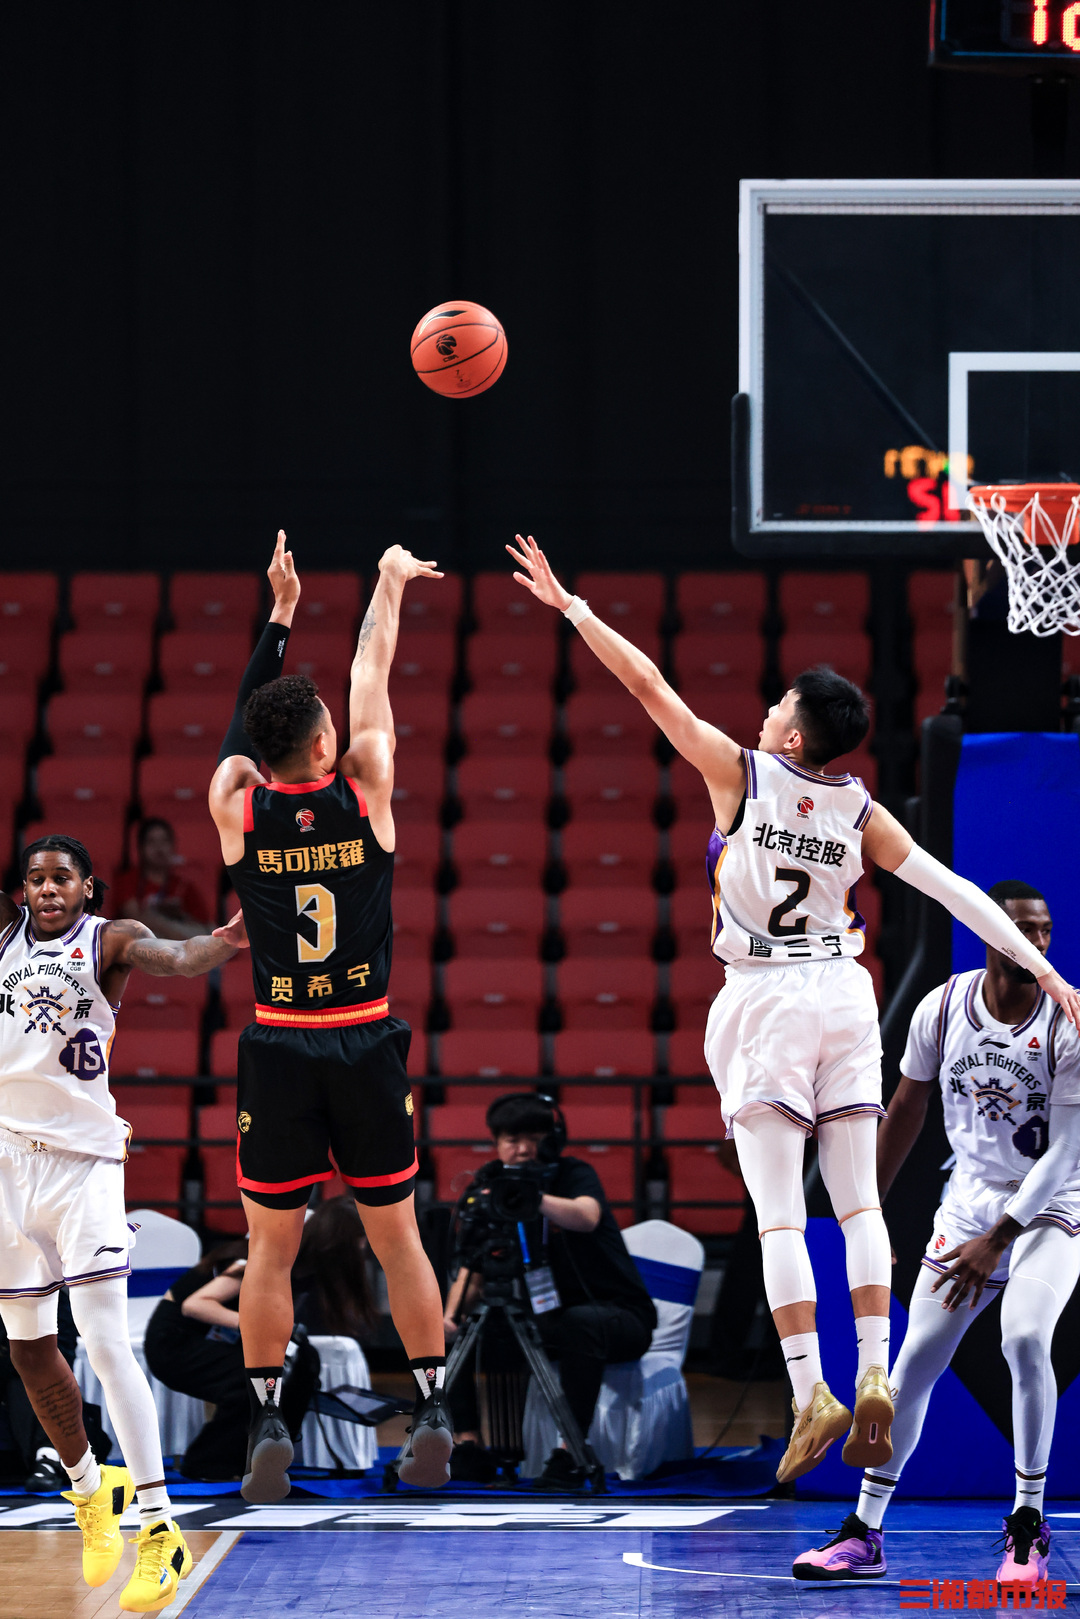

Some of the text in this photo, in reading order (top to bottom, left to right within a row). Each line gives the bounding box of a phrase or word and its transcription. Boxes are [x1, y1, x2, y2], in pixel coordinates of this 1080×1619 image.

[257, 838, 365, 874] 馬可波羅
[752, 823, 846, 867] 北京控股
[768, 866, 811, 937] 2
[295, 883, 337, 963] 3
[2, 964, 35, 992] ROYAL
[271, 963, 371, 1003] 贺希宁
[73, 999, 94, 1020] 京
[71, 1040, 100, 1071] 15
[950, 1052, 1041, 1091] ROYAL FIGHTERS
[1026, 1092, 1047, 1112] 京
